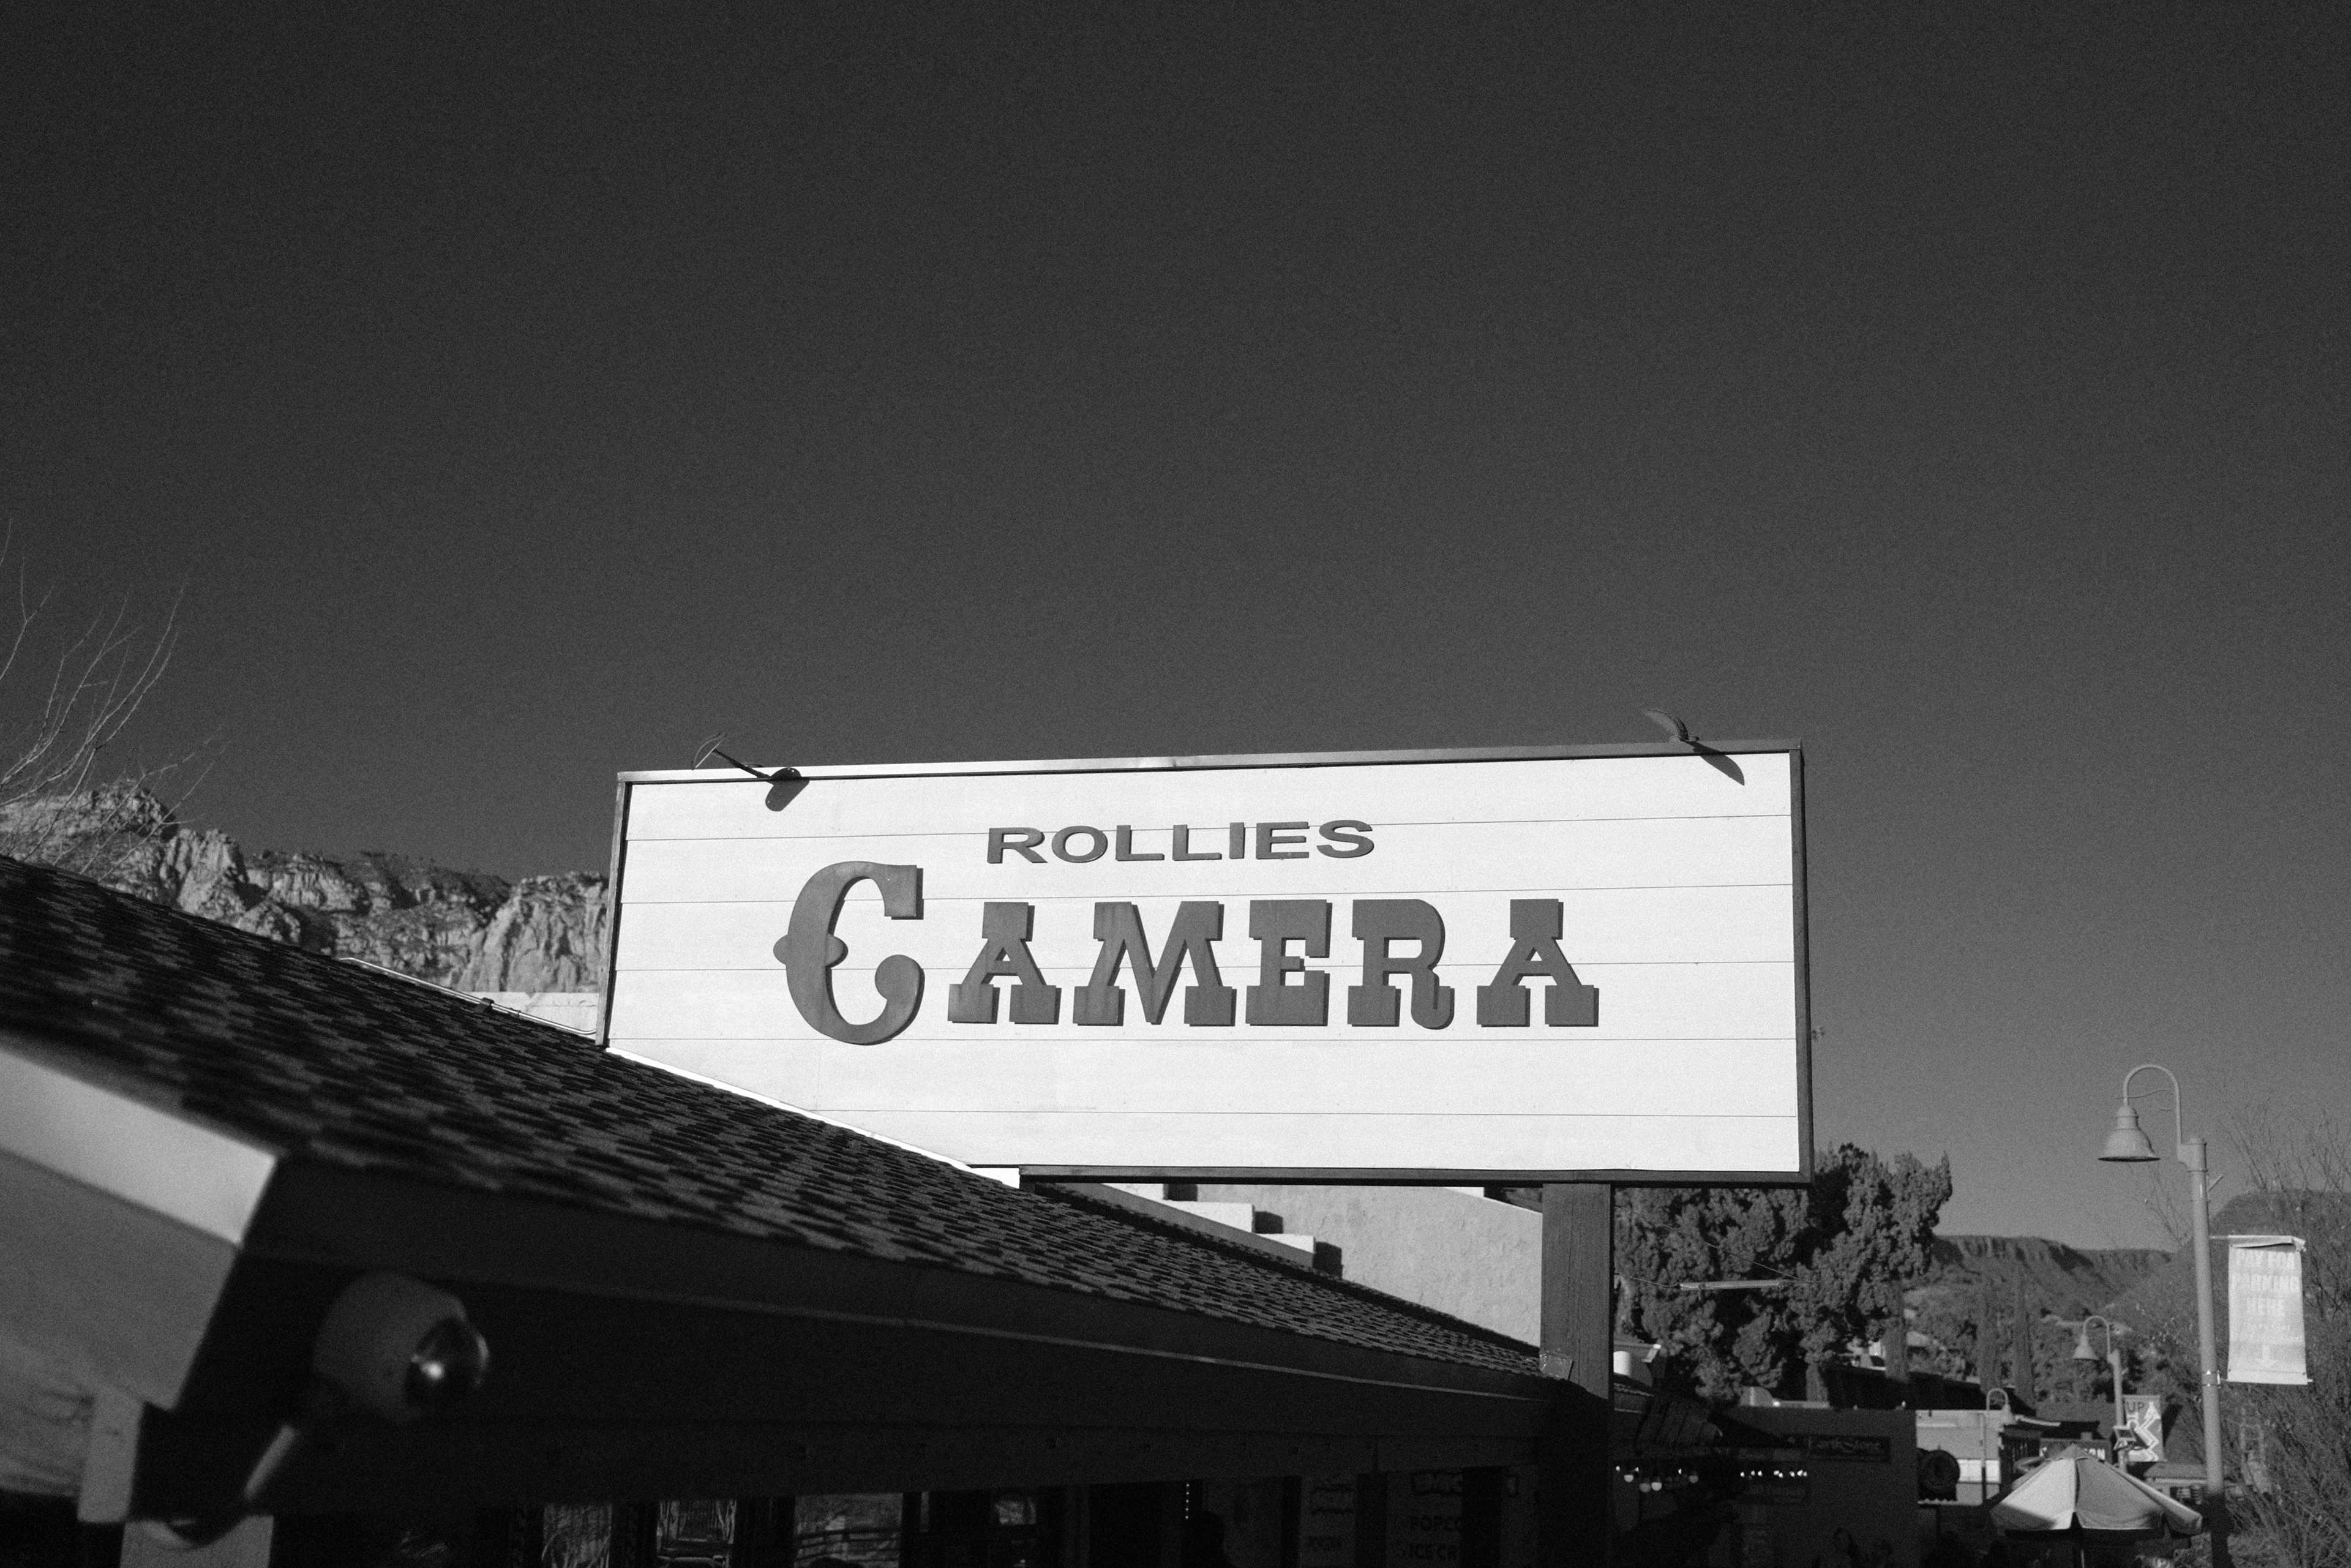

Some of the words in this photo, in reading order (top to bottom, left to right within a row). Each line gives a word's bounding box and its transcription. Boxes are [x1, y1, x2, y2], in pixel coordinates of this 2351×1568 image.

[986, 819, 1374, 865] ROLLIES
[773, 860, 1599, 1046] CAMERA
[2236, 1250, 2263, 1268] PAY
[2268, 1251, 2295, 1270] FOR
[2231, 1272, 2300, 1294] PARKING
[2246, 1297, 2285, 1317] HERE
[2126, 1401, 2145, 1413] UP
